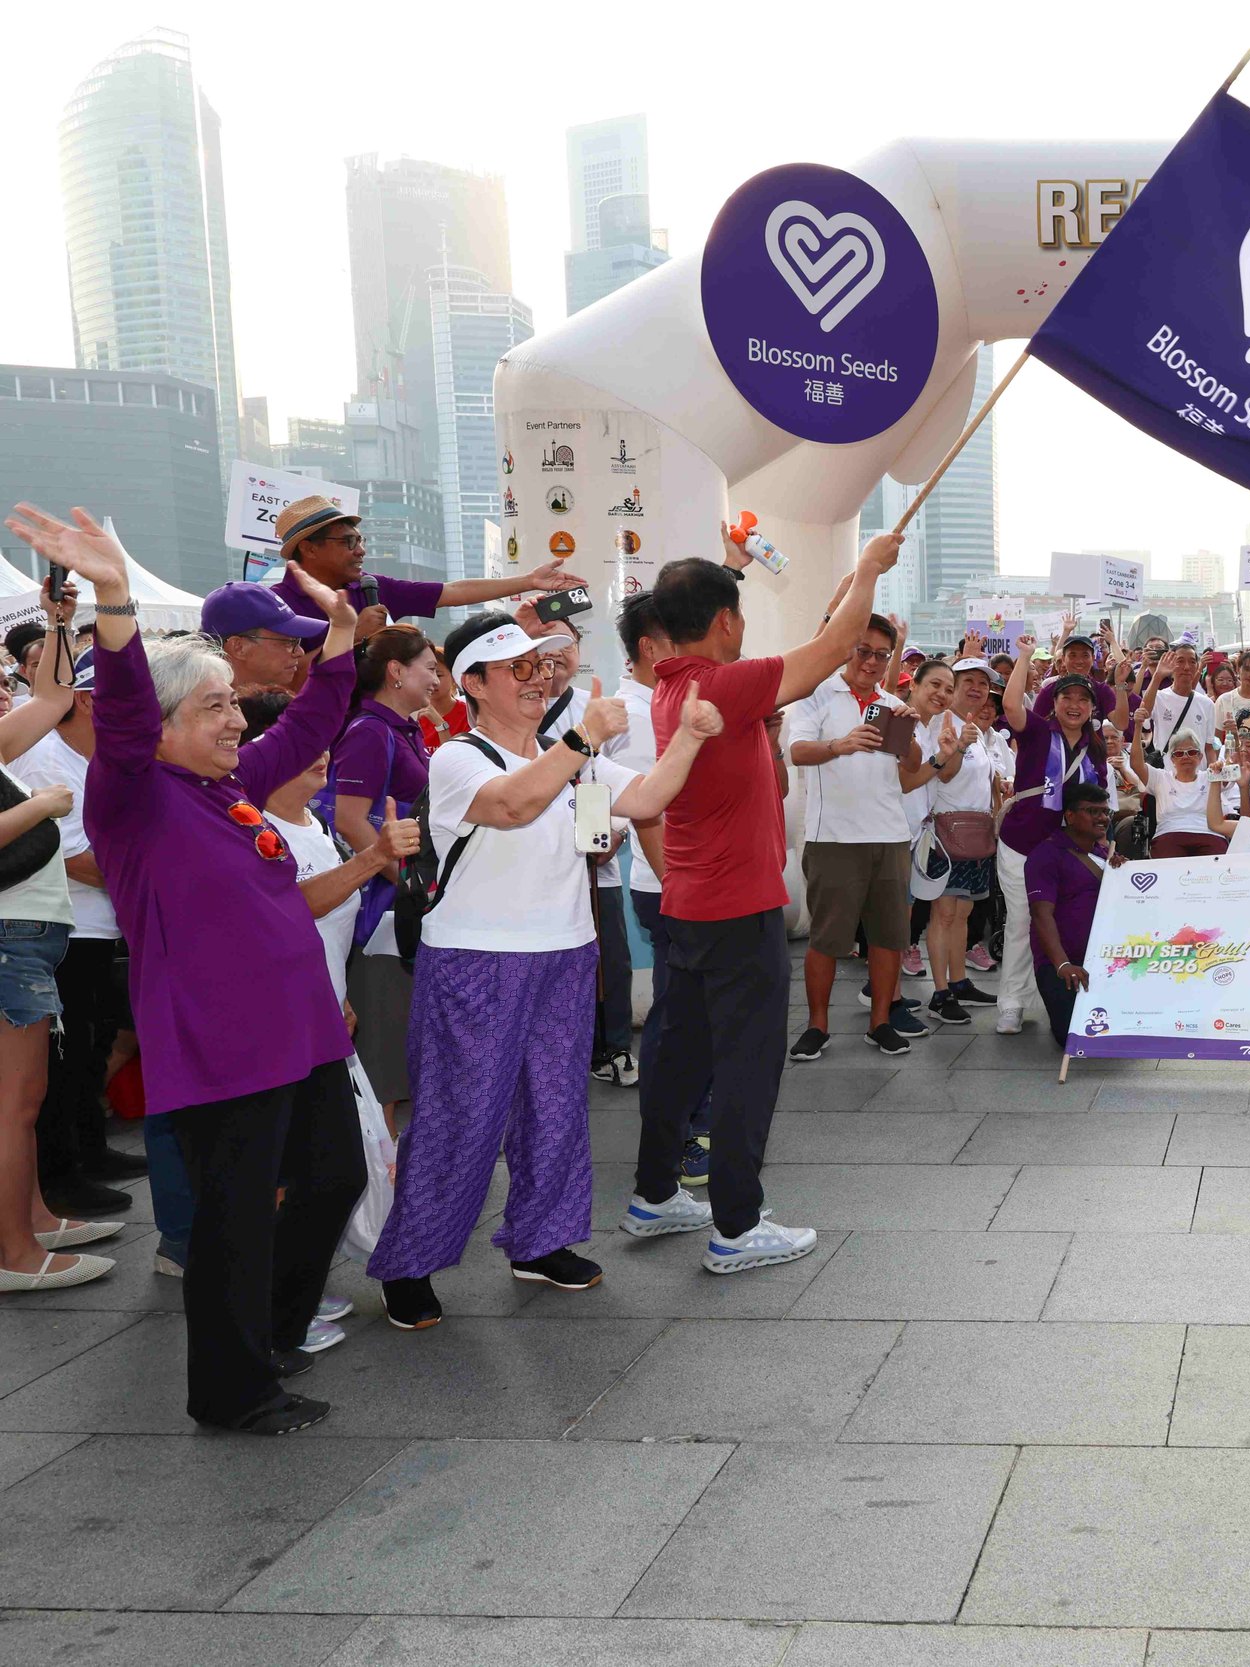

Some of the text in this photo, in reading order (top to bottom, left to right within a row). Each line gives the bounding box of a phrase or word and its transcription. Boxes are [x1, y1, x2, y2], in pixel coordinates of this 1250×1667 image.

[1037, 179, 1152, 249] RE
[748, 337, 898, 382] Blossom Seeds
[1146, 324, 1239, 414] Blossom
[804, 378, 844, 406] 福善
[526, 420, 581, 430] Event Partners
[252, 493, 280, 505] EAST
[256, 508, 277, 524] Zo
[1108, 577, 1135, 589] Zone 3-4
[983, 638, 1010, 655] PURPLE
[1100, 944, 1158, 959] READY
[1160, 944, 1192, 958] SET
[1147, 958, 1200, 974] 2026
[1214, 971, 1232, 981] CHOPE
